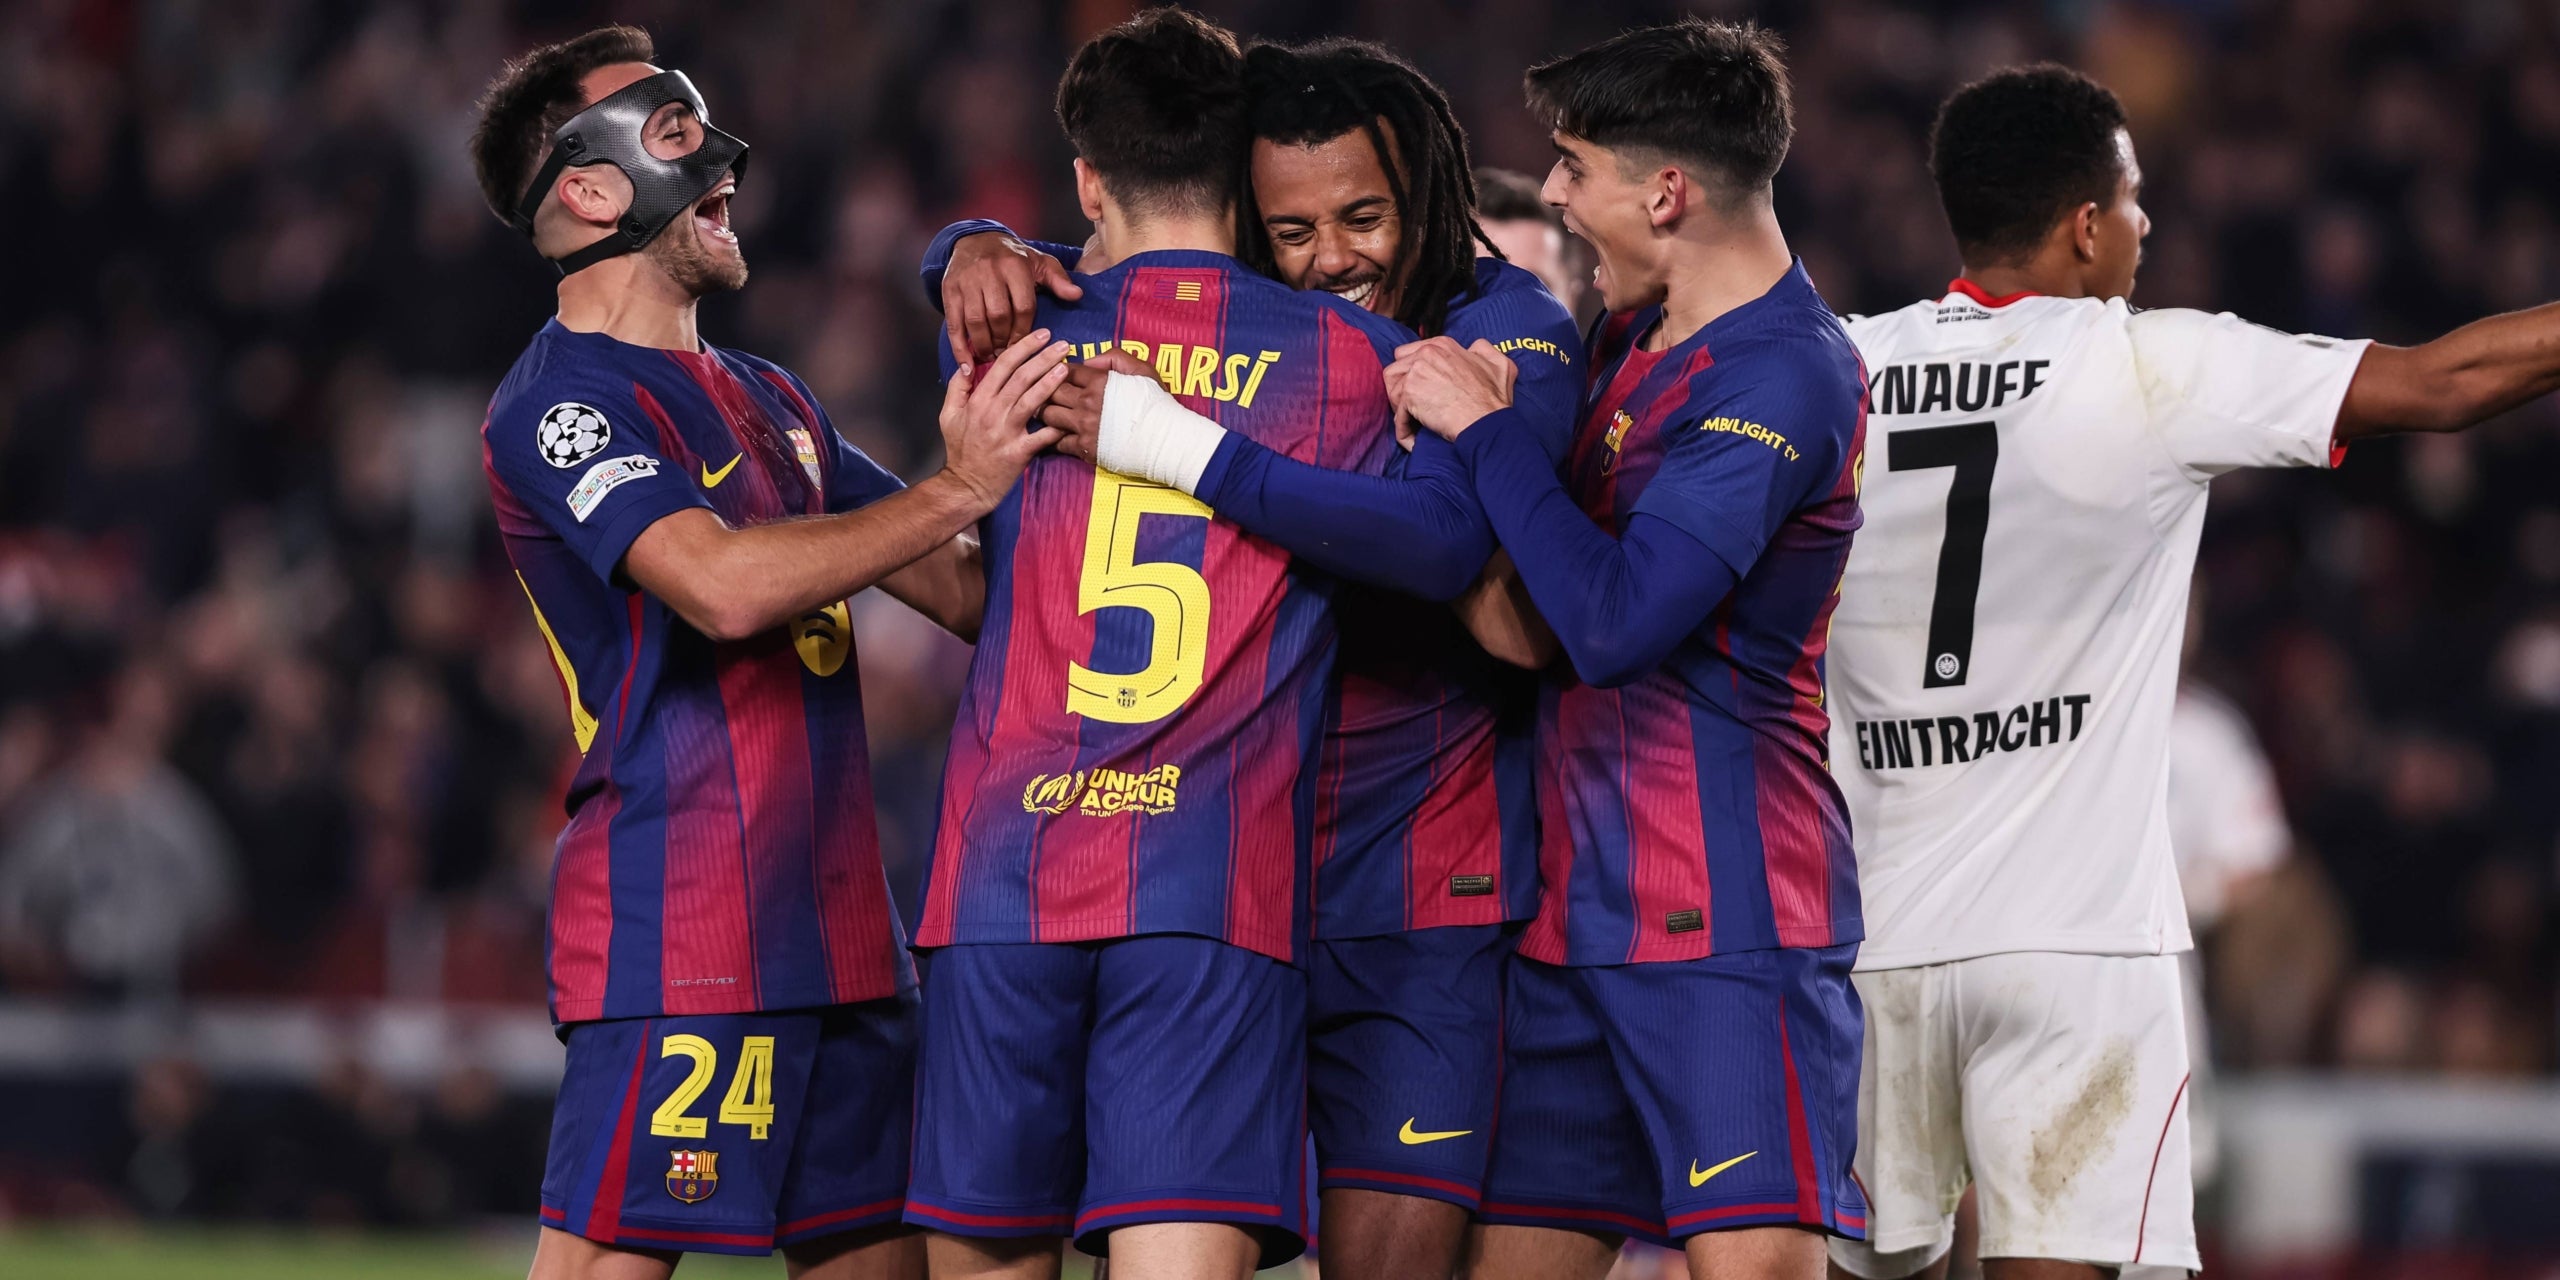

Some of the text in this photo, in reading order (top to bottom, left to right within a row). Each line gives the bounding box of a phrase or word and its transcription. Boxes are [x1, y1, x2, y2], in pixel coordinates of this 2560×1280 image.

[1493, 337, 1570, 365] ILIGHT tv
[1063, 340, 1281, 409] ARSÍ
[560, 419, 583, 445] 5
[1700, 416, 1800, 461] MBILIGHT tv
[573, 466, 625, 512] FOUNDATION
[1888, 421, 1998, 688] 7
[1066, 464, 1214, 724] 5
[1856, 694, 2091, 769] EINTRACHT
[1080, 783, 1176, 810] ACNUR
[1089, 764, 1181, 792] UNHCR
[1080, 808, 1097, 816] The
[1098, 809, 1111, 817] UN
[1145, 804, 1175, 816] Agency
[651, 1034, 775, 1140] 24
